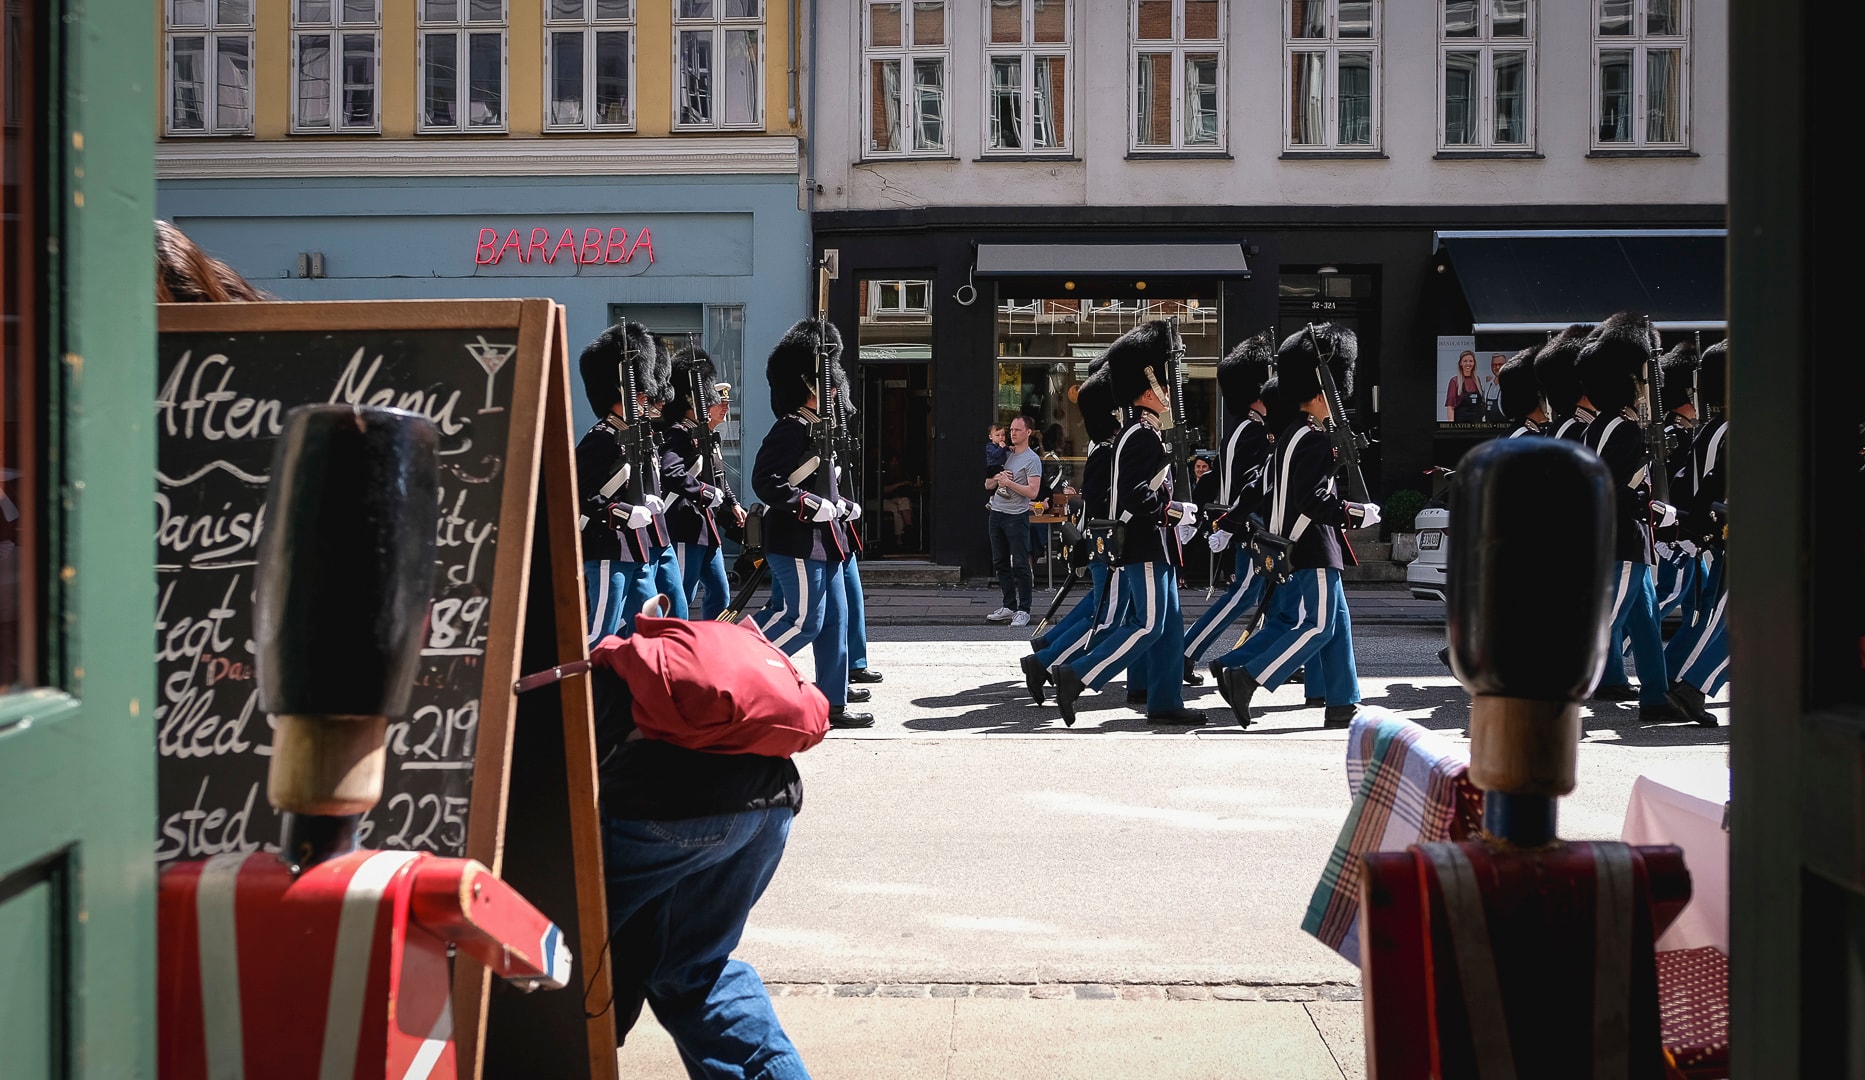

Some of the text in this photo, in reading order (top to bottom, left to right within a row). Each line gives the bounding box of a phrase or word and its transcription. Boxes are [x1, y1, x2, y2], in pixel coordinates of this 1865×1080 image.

[475, 227, 655, 265] BARABBA
[1311, 301, 1336, 310] 32-32A
[154, 349, 284, 441] Aften
[154, 775, 260, 861] sted
